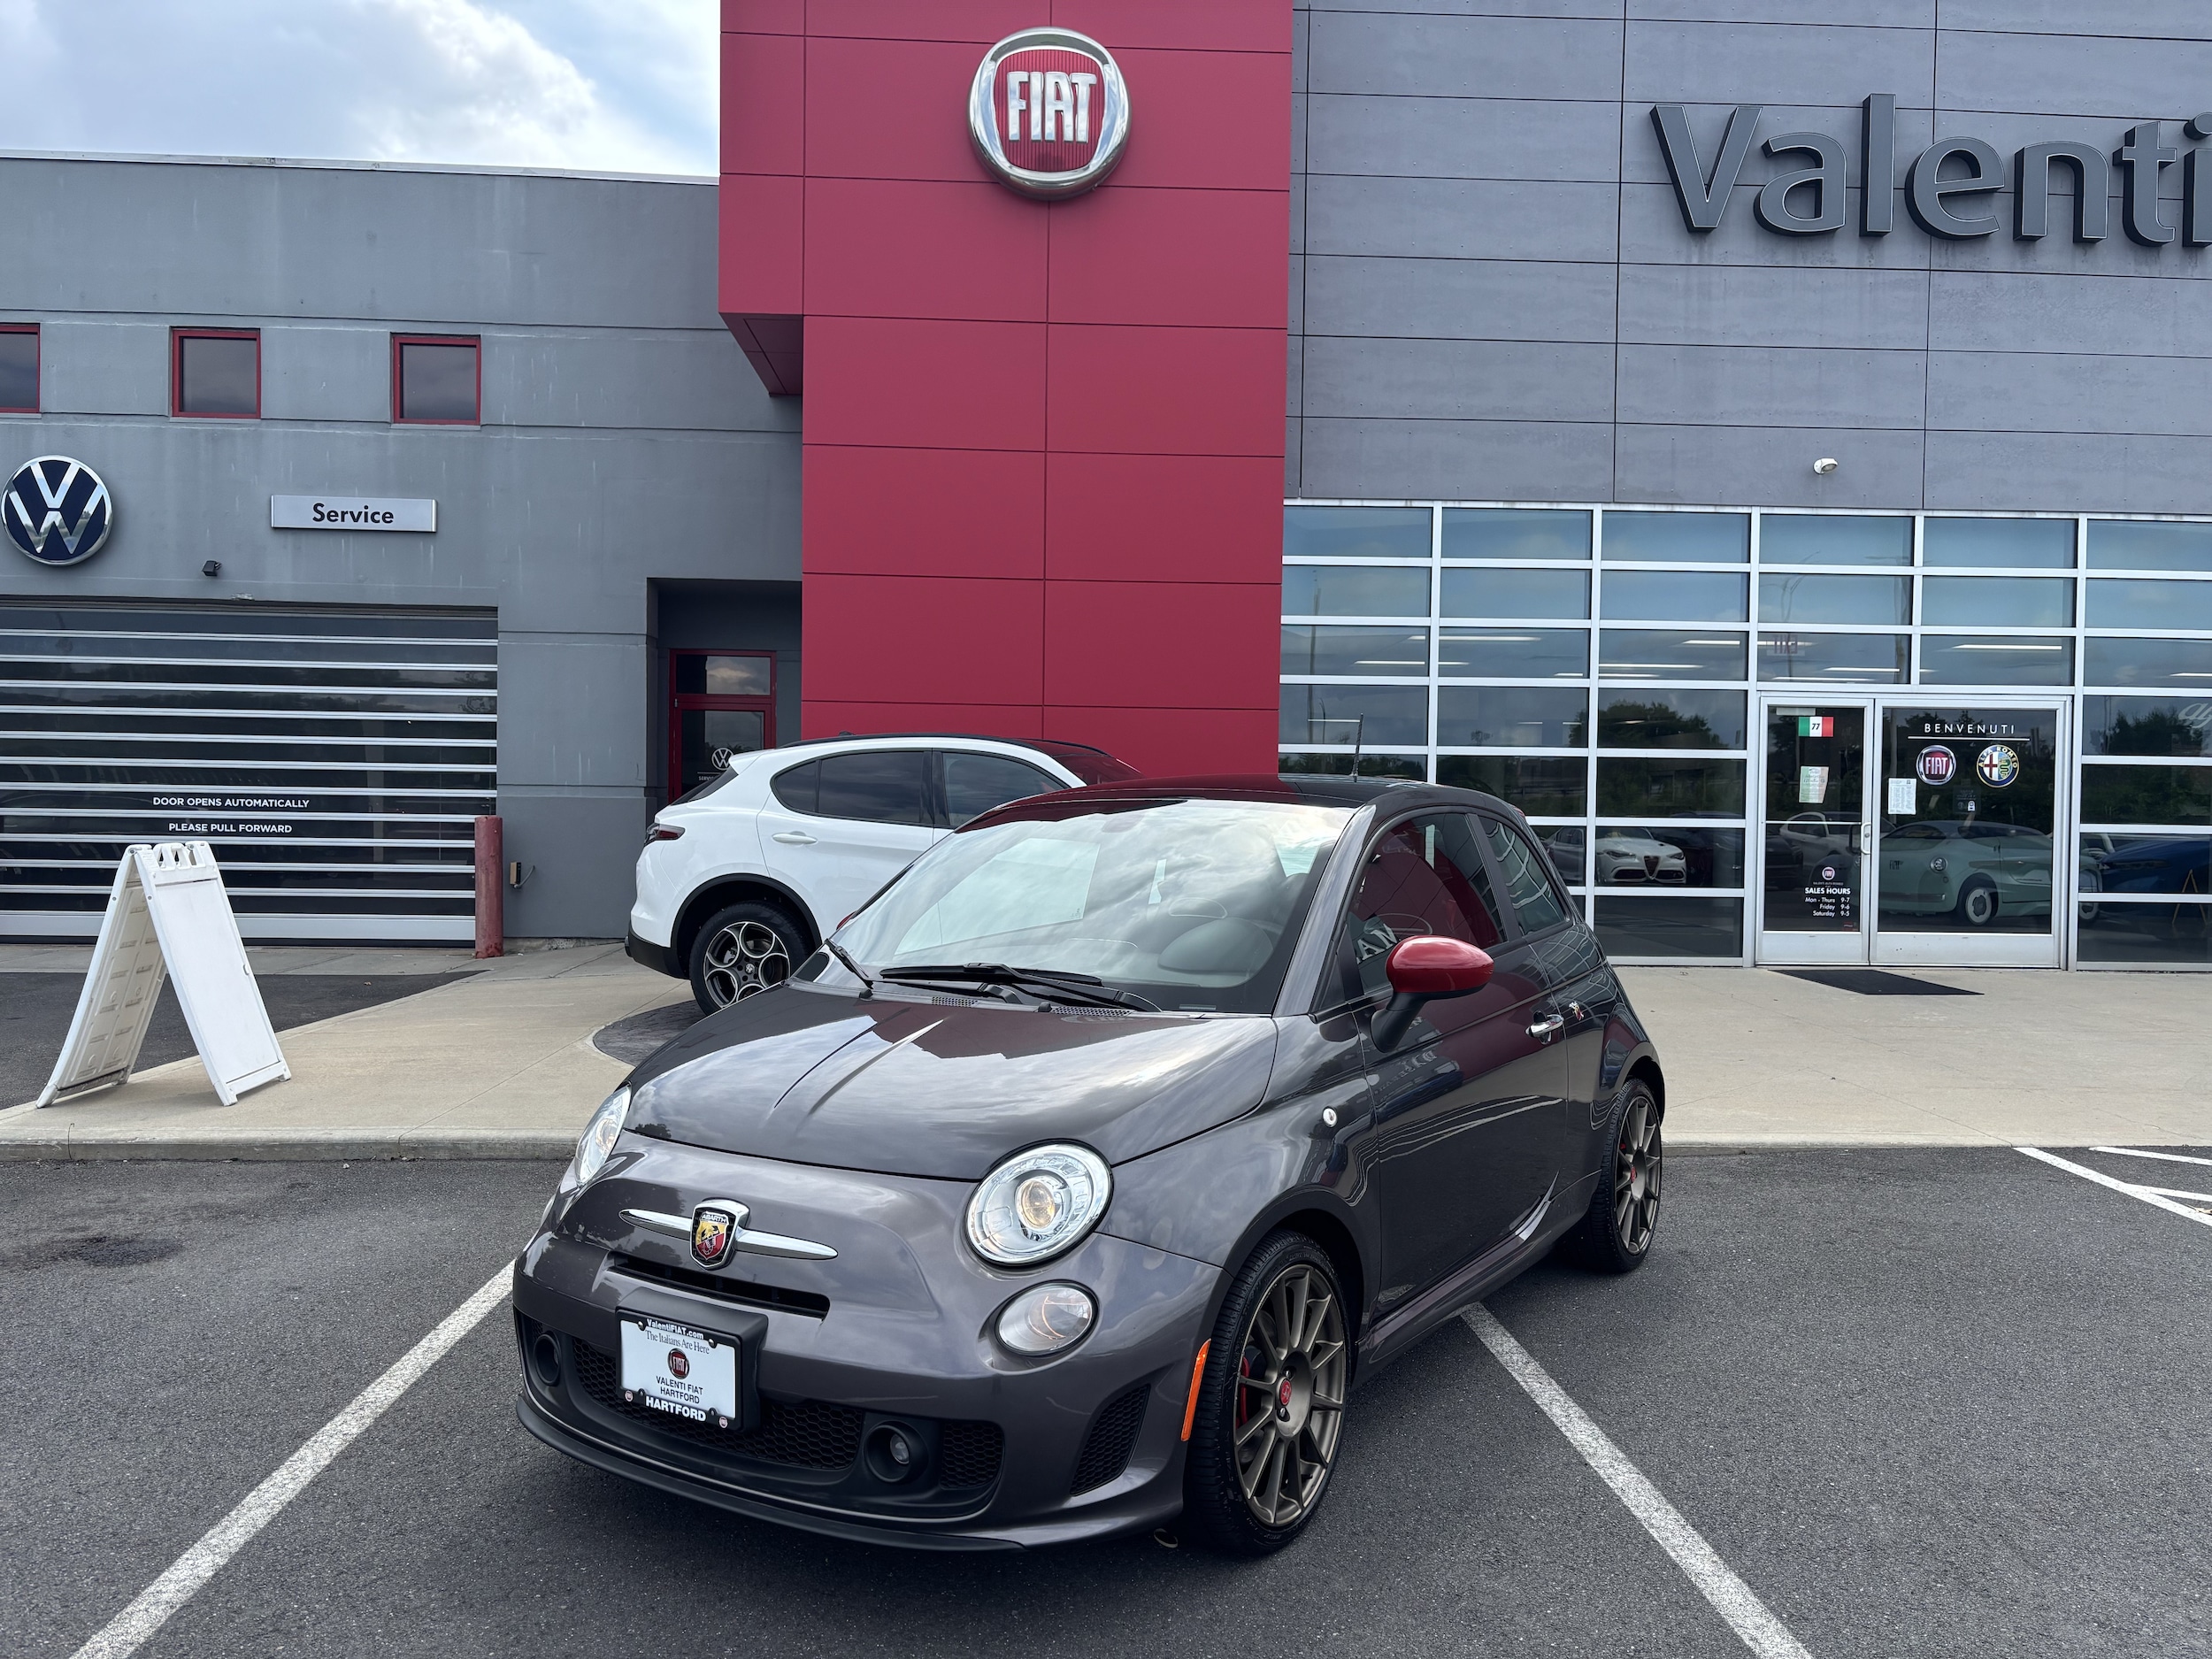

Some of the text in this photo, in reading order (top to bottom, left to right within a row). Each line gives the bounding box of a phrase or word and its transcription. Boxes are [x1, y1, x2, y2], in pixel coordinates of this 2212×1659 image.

[1007, 72, 1097, 143] FIAT
[1649, 93, 2212, 248] Valenti
[5, 458, 106, 556] VW
[312, 503, 395, 524] Service
[1924, 724, 2015, 734] BENVENUTI
[1925, 757, 1948, 775] FIAT
[1996, 746, 2018, 768] ROMEO
[153, 797, 310, 808] DOOR OPENS AUTOMATICALLY
[169, 823, 293, 833] PLEASE PULL FORWARD
[702, 1214, 726, 1223] ABARTH
[647, 1318, 704, 1340] ValentiFIAT.com
[646, 1330, 710, 1355] The Italians Are Here
[672, 1356, 685, 1371] FIAT
[657, 1376, 703, 1395] VALENTI FIAT
[660, 1386, 700, 1404] HARTFORD
[646, 1396, 707, 1421] HARTFORD
